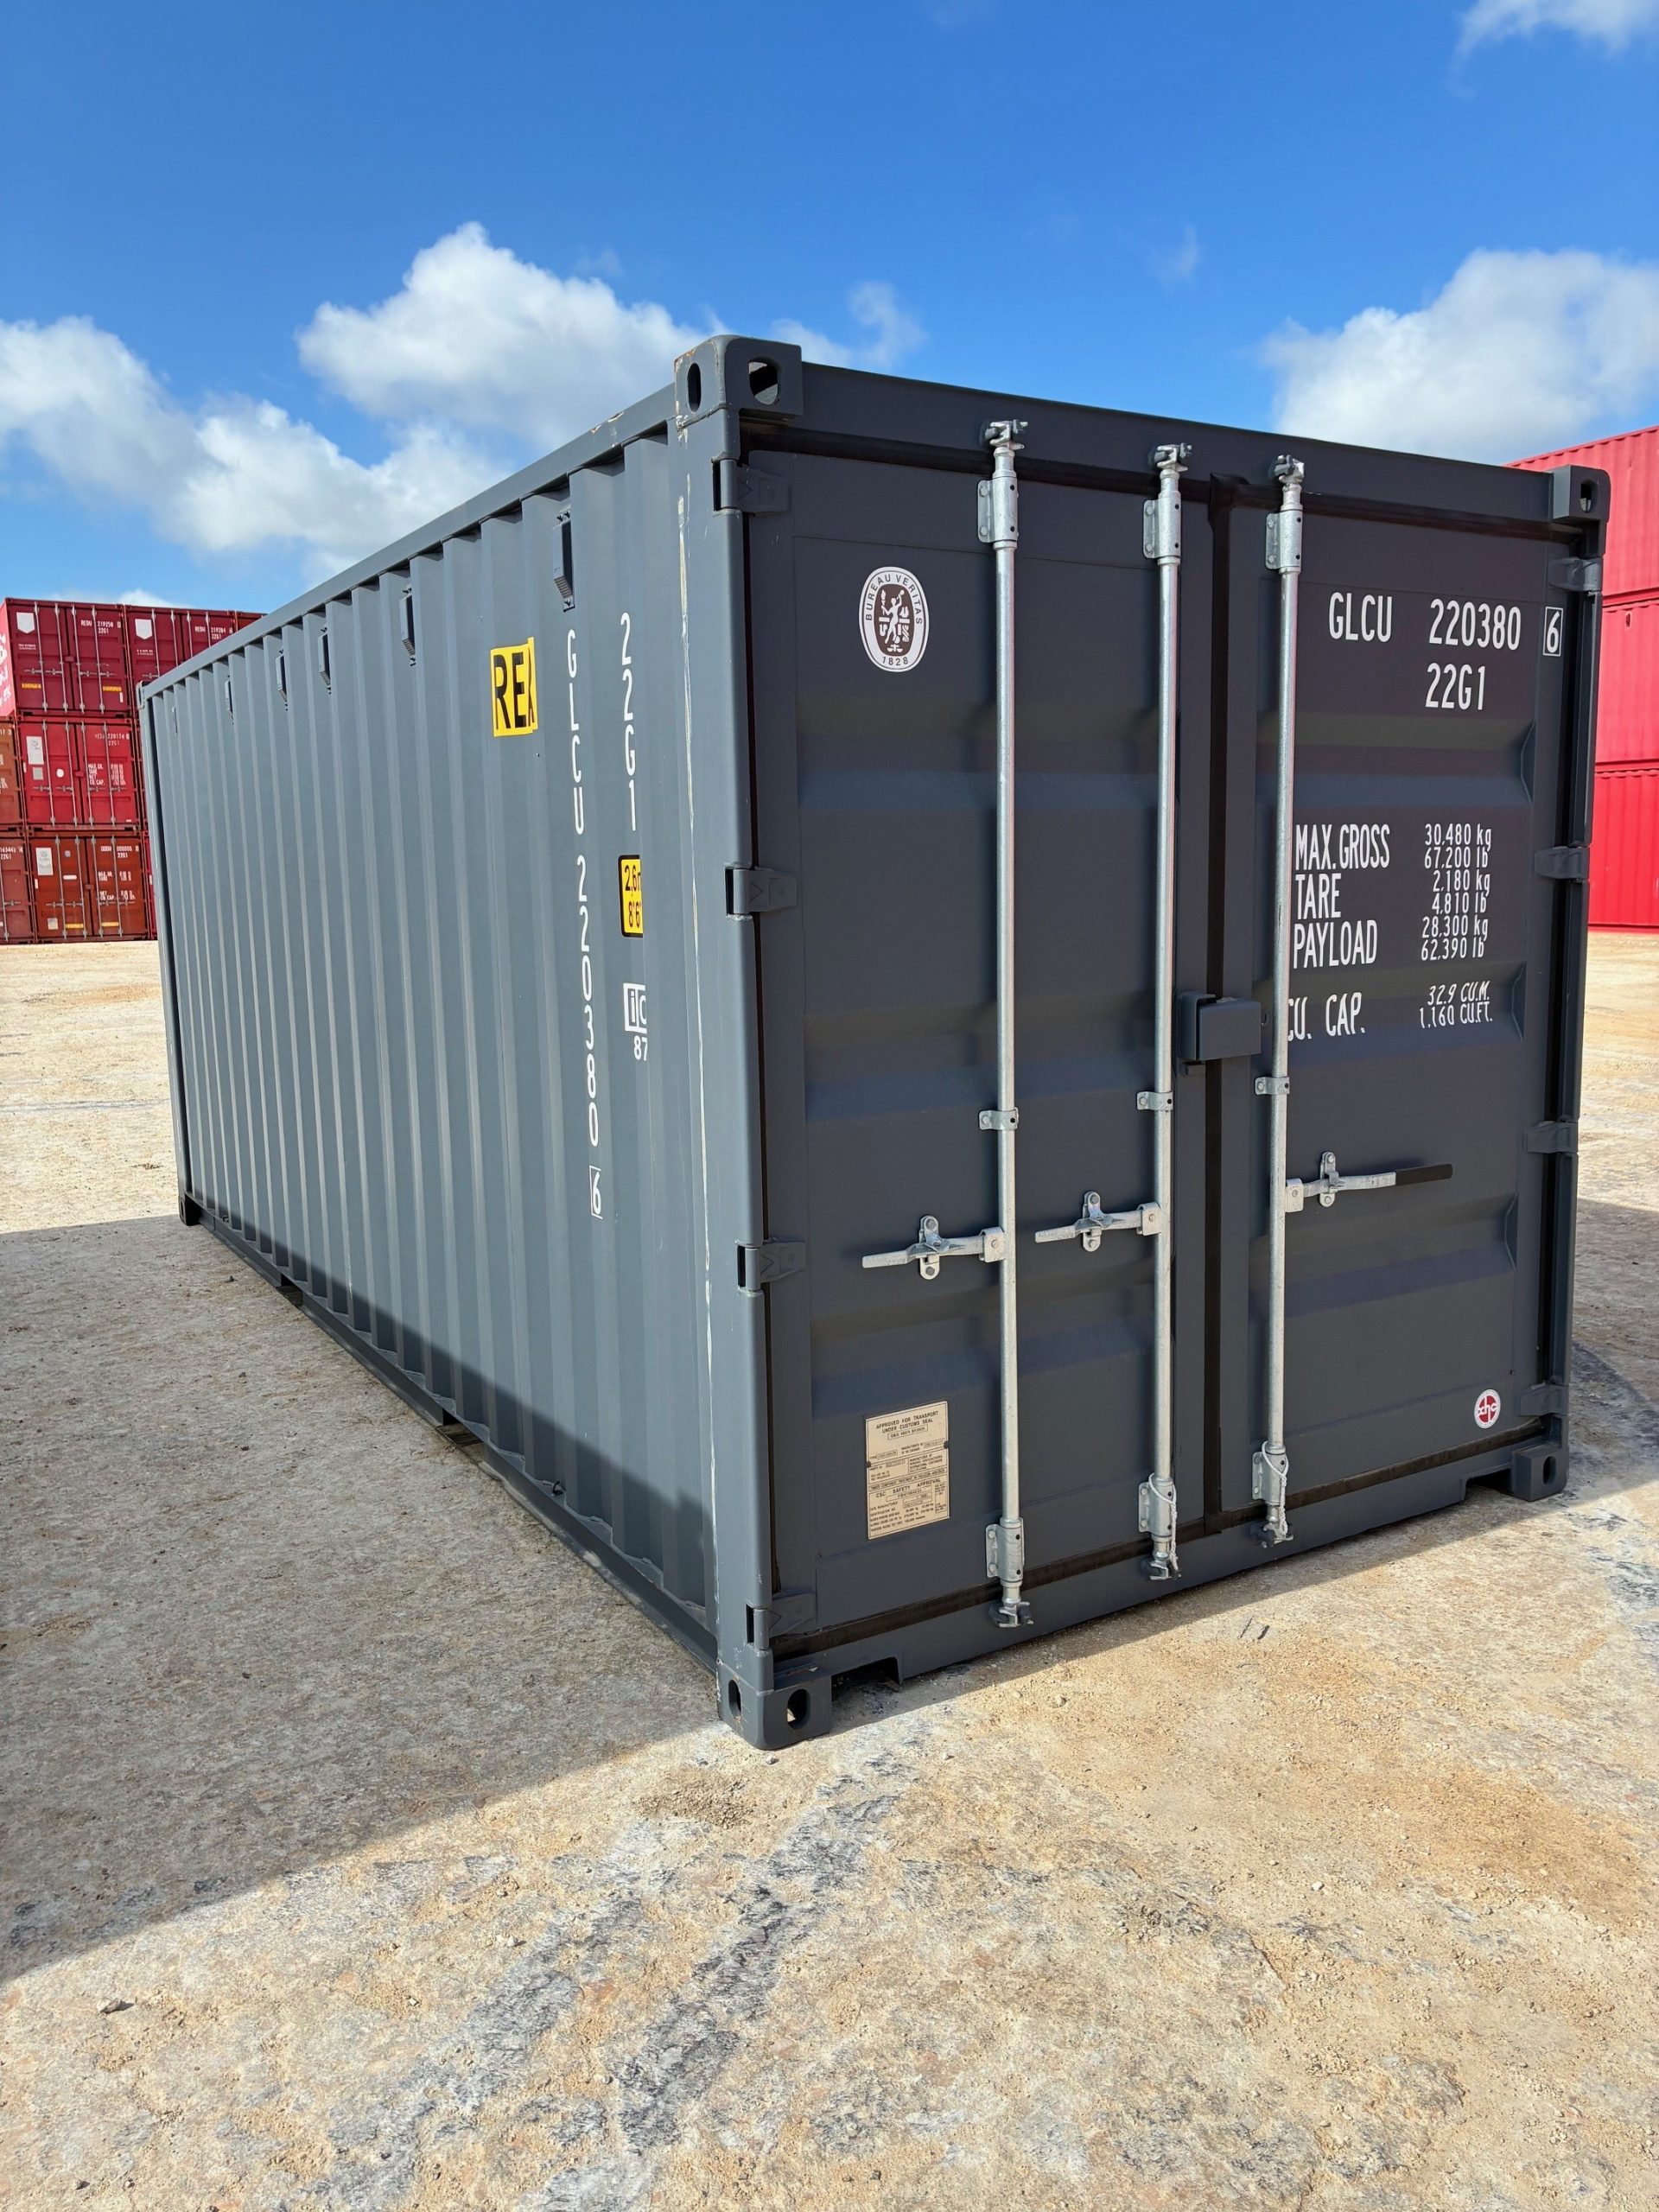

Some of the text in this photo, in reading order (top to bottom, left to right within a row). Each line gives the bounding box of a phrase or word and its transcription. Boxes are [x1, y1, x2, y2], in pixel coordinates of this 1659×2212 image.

[866, 574, 922, 624] BUREAU VERITAS
[1329, 592, 1561, 654] GLCU 220380 6
[883, 657, 908, 665] 1828
[1426, 663, 1485, 711] 22G1
[620, 612, 636, 831] 22G1
[1425, 824, 1492, 851] 30,480 kg
[1425, 847, 1488, 868] 67,200 lb
[1433, 869, 1490, 896] 2,180 kg
[1296, 873, 1341, 920] TARE
[1432, 892, 1486, 915] 4,810 lb
[567, 629, 602, 1215] GLCU 220380 6
[1422, 914, 1488, 941] 28,300 kg
[1293, 920, 1377, 969] PAYLOAD
[1421, 937, 1484, 961] 62,390 lb
[1428, 983, 1457, 1005] 32.9
[1326, 992, 1365, 1037] CAP.
[1460, 1001, 1493, 1024] CU.FT.
[634, 1035, 647, 1061] 87
[876, 1420, 899, 1429] APPROVED
[914, 1411, 939, 1420] TRANSPORT
[899, 1421, 920, 1430] CUSTOMS
[893, 1485, 910, 1494] SAFETY
[917, 1478, 941, 1487] APPROVAL
